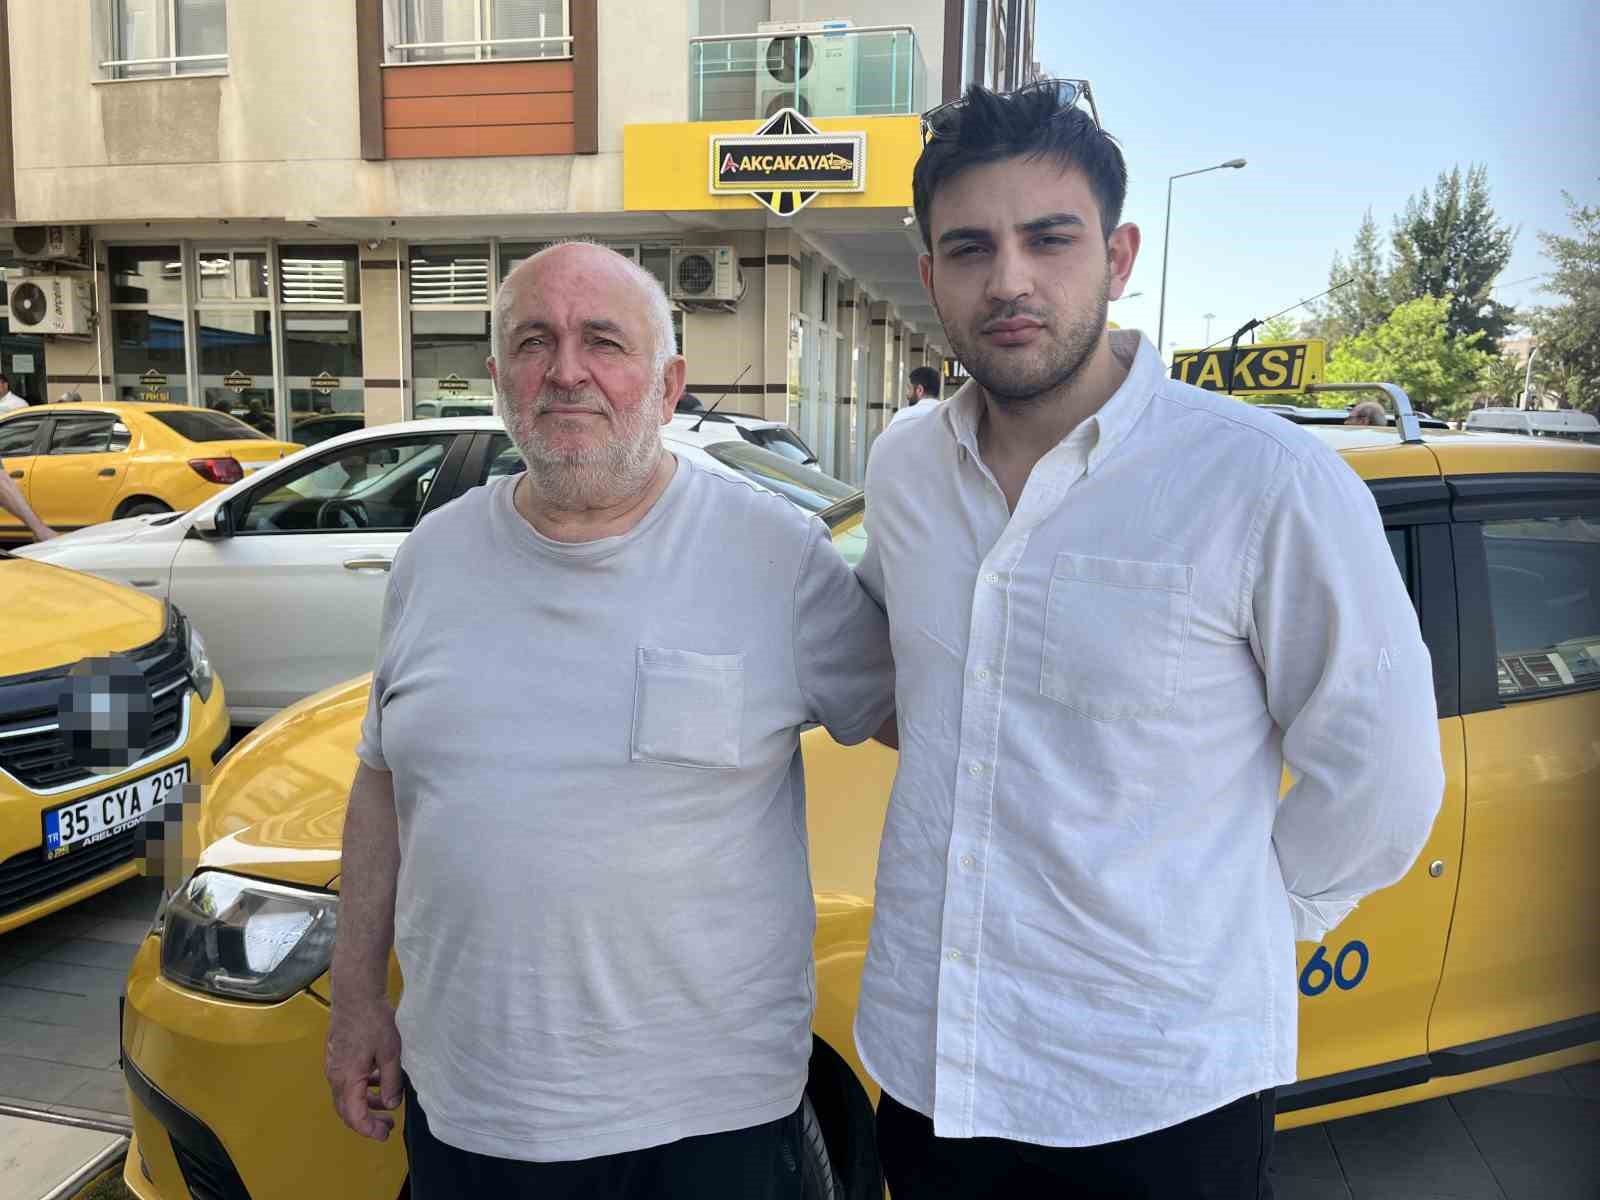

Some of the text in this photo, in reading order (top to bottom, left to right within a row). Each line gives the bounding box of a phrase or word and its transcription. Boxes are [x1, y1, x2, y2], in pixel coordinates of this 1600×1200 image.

[739, 154, 829, 174] AKÇAKAYA
[61, 804, 90, 841] 35
[102, 786, 141, 825] CYA
[48, 832, 59, 844] TR
[1296, 940, 1369, 996] 60
